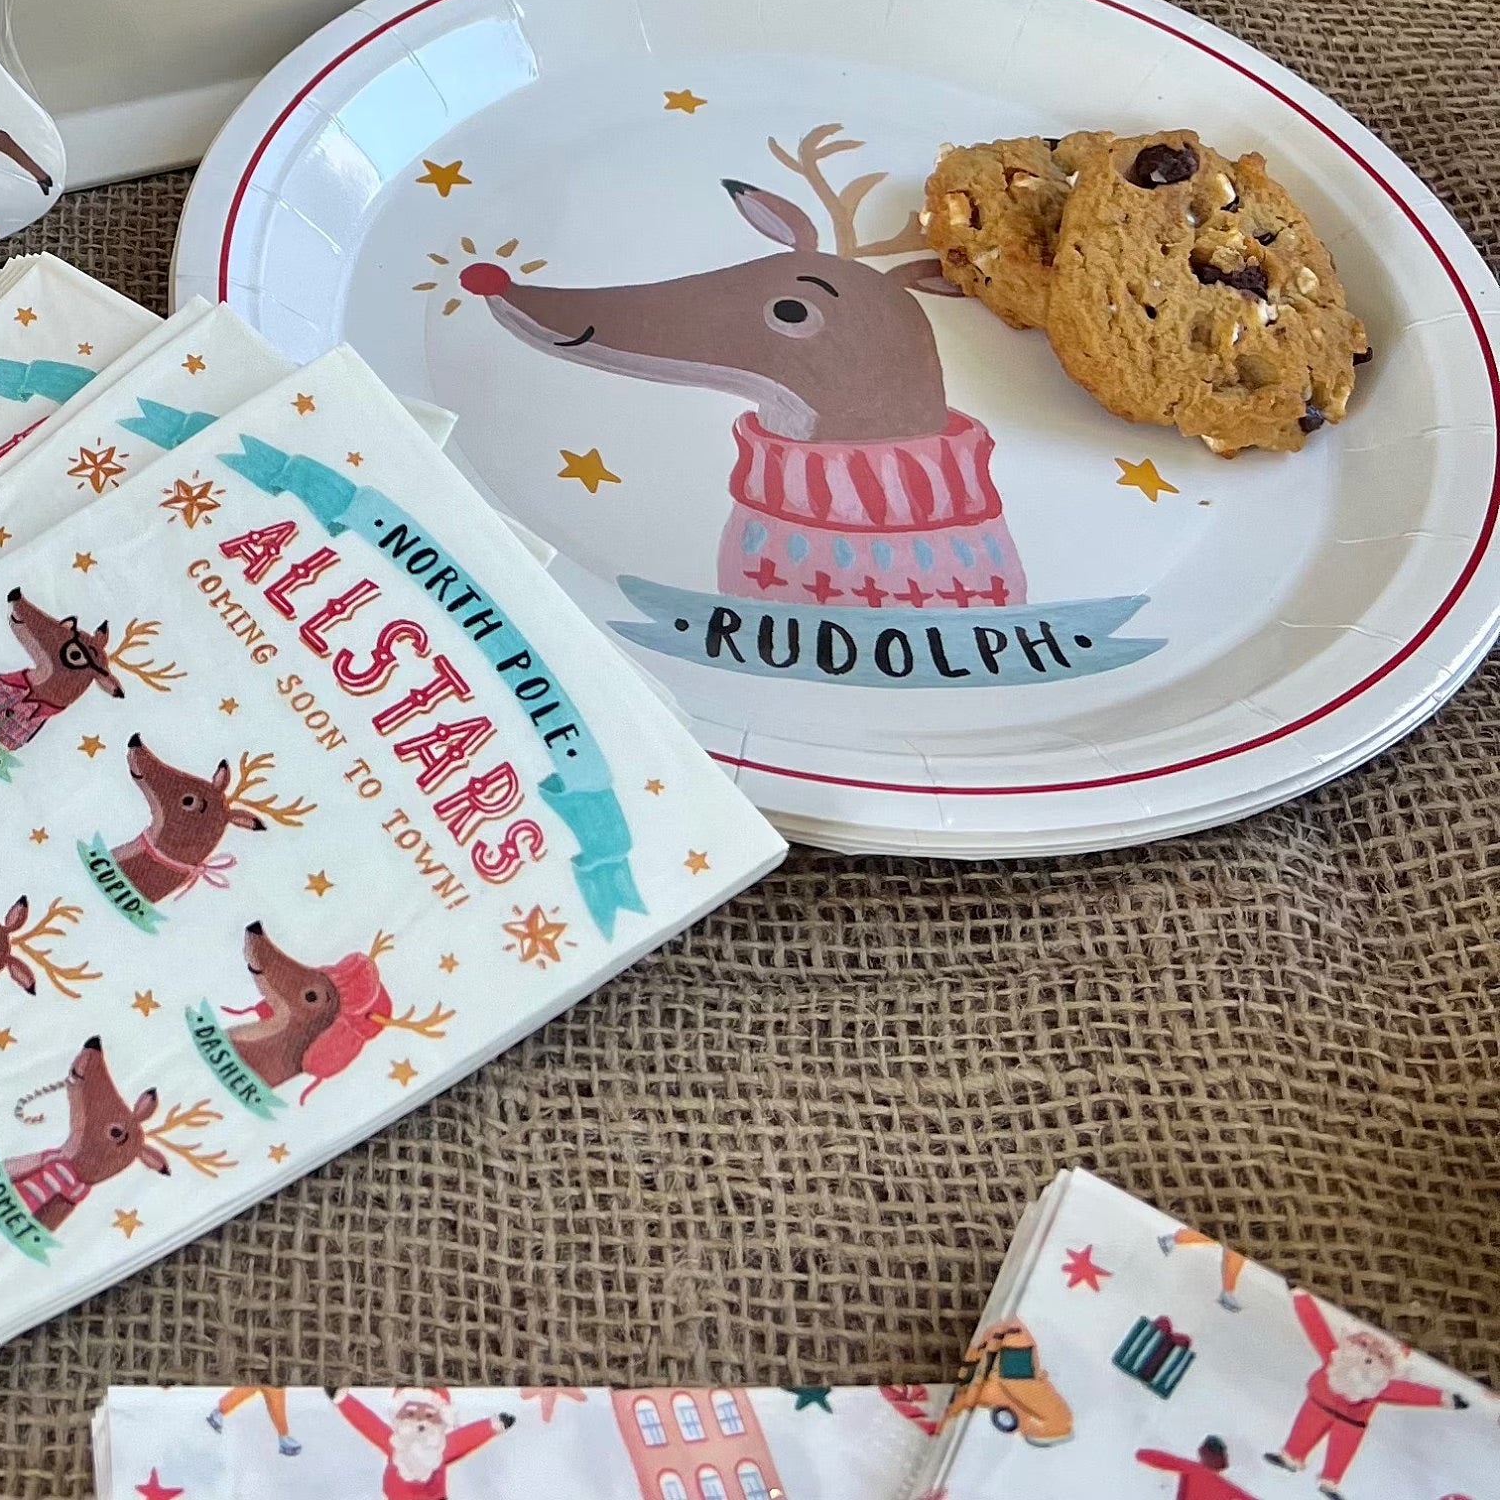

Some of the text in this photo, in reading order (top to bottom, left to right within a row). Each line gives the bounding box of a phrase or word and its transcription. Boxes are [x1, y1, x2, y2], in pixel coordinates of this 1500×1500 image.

[217, 519, 549, 886] ALLSTARS
[379, 523, 580, 751] NORTH POLE
[705, 607, 1071, 678] RUDOLPH
[186, 556, 470, 911] COMING SOON TO TOWN!
[89, 856, 141, 913] CUPID
[195, 1023, 260, 1103] DASHER
